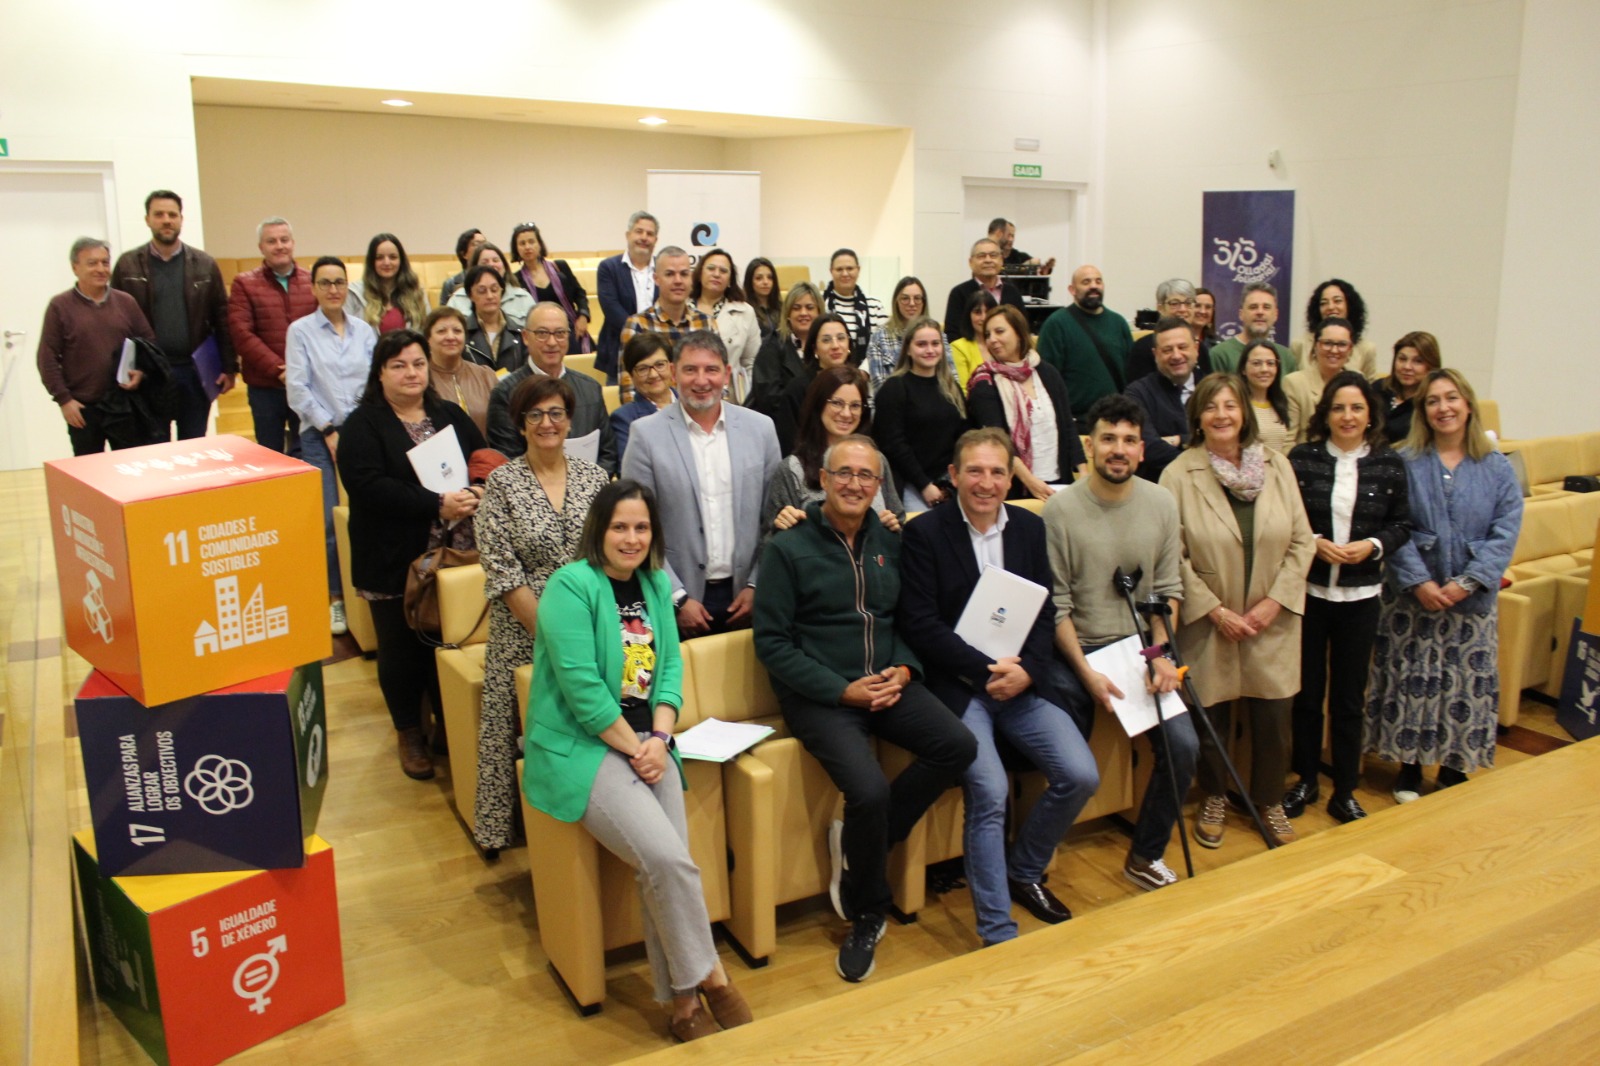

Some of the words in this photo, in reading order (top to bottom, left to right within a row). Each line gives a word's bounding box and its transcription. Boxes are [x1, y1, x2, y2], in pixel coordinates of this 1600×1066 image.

[1014, 165, 1041, 176] SAIDA
[61, 504, 72, 537] 9
[198, 518, 247, 542] CIDADES
[248, 515, 257, 532] E
[163, 529, 191, 567] 11
[199, 529, 279, 559] COMUNIDADES
[201, 551, 260, 577] SOSTIBLES
[119, 734, 138, 763] PARA
[156, 731, 180, 794] OBXECTIVOS
[123, 763, 145, 812] ALIANZAS
[143, 771, 163, 811] LOGRAR
[165, 796, 182, 810] OS
[128, 823, 166, 847] 17
[219, 899, 277, 932] IGUALDADE
[221, 931, 236, 948] DE
[237, 915, 277, 941] XÉNERO
[190, 926, 210, 958] 5
